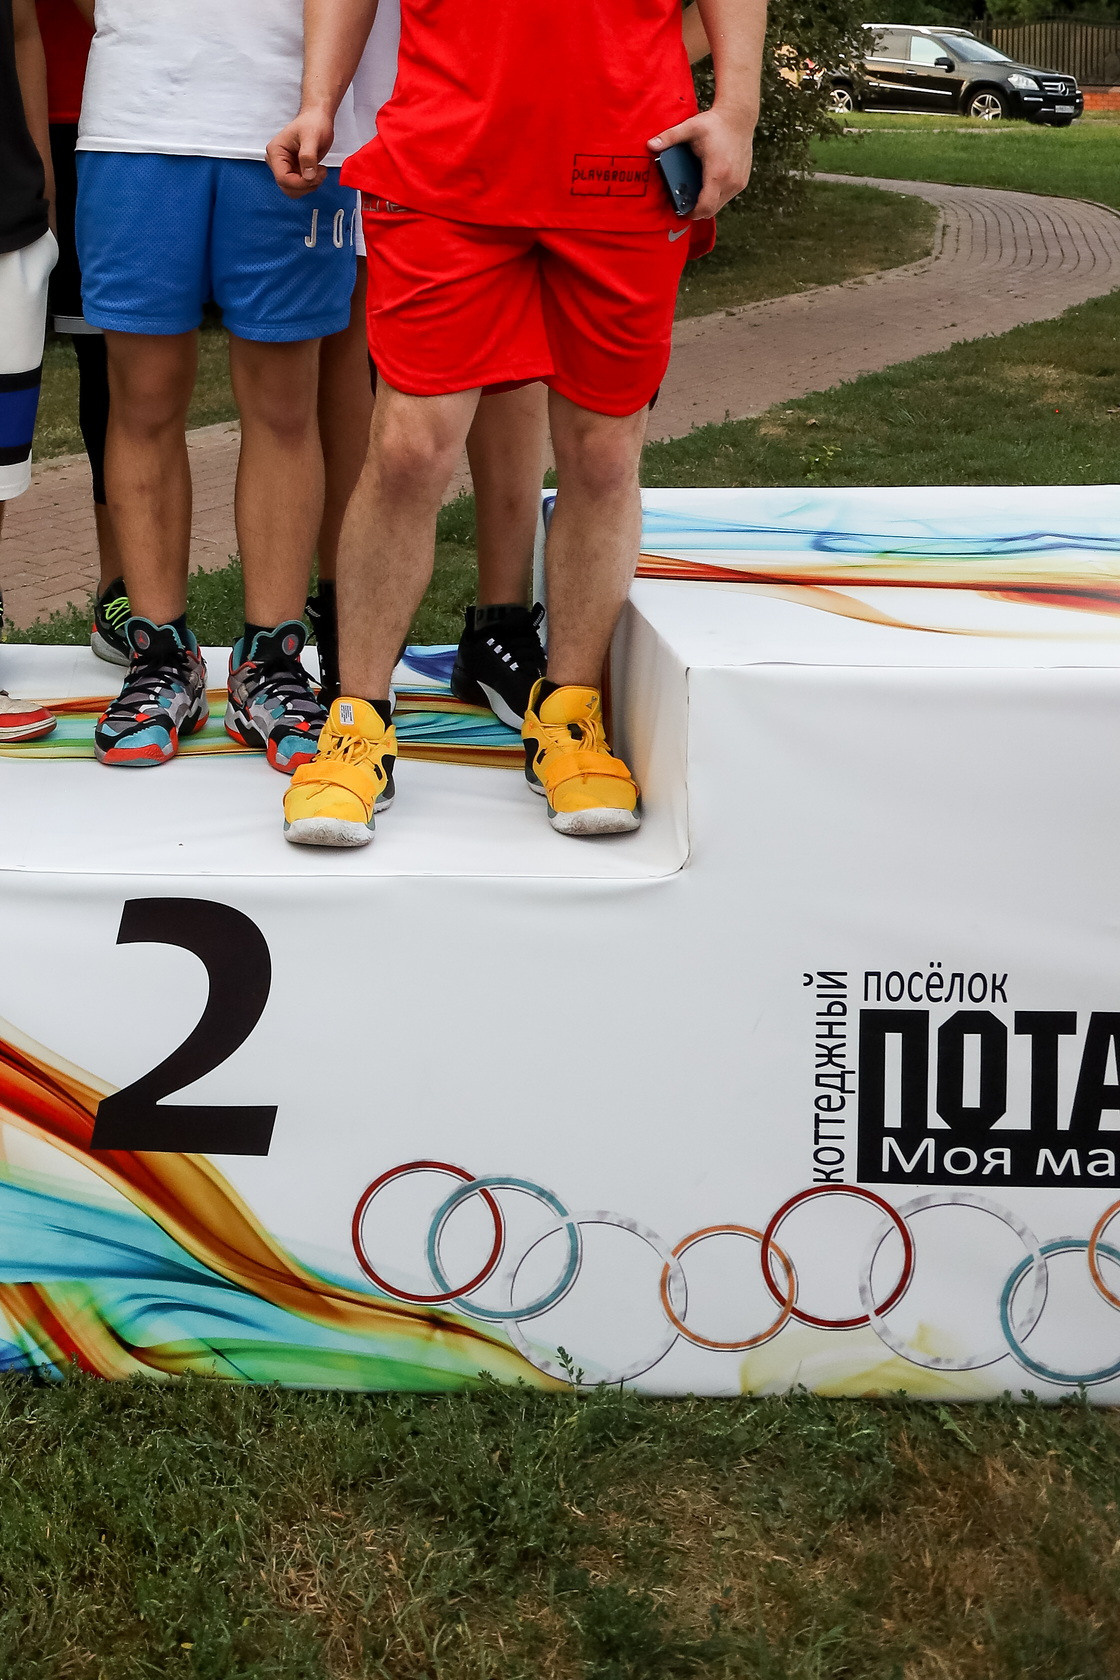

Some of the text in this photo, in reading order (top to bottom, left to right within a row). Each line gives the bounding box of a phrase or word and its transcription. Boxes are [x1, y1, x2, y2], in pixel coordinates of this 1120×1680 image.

[572, 169, 649, 183] PLAYGROUND
[304, 208, 357, 248] JO
[863, 961, 1008, 1003] посёлок
[91, 897, 278, 1156] 2
[802, 970, 855, 1183] коттеджный
[881, 1136, 1012, 1176] Моя
